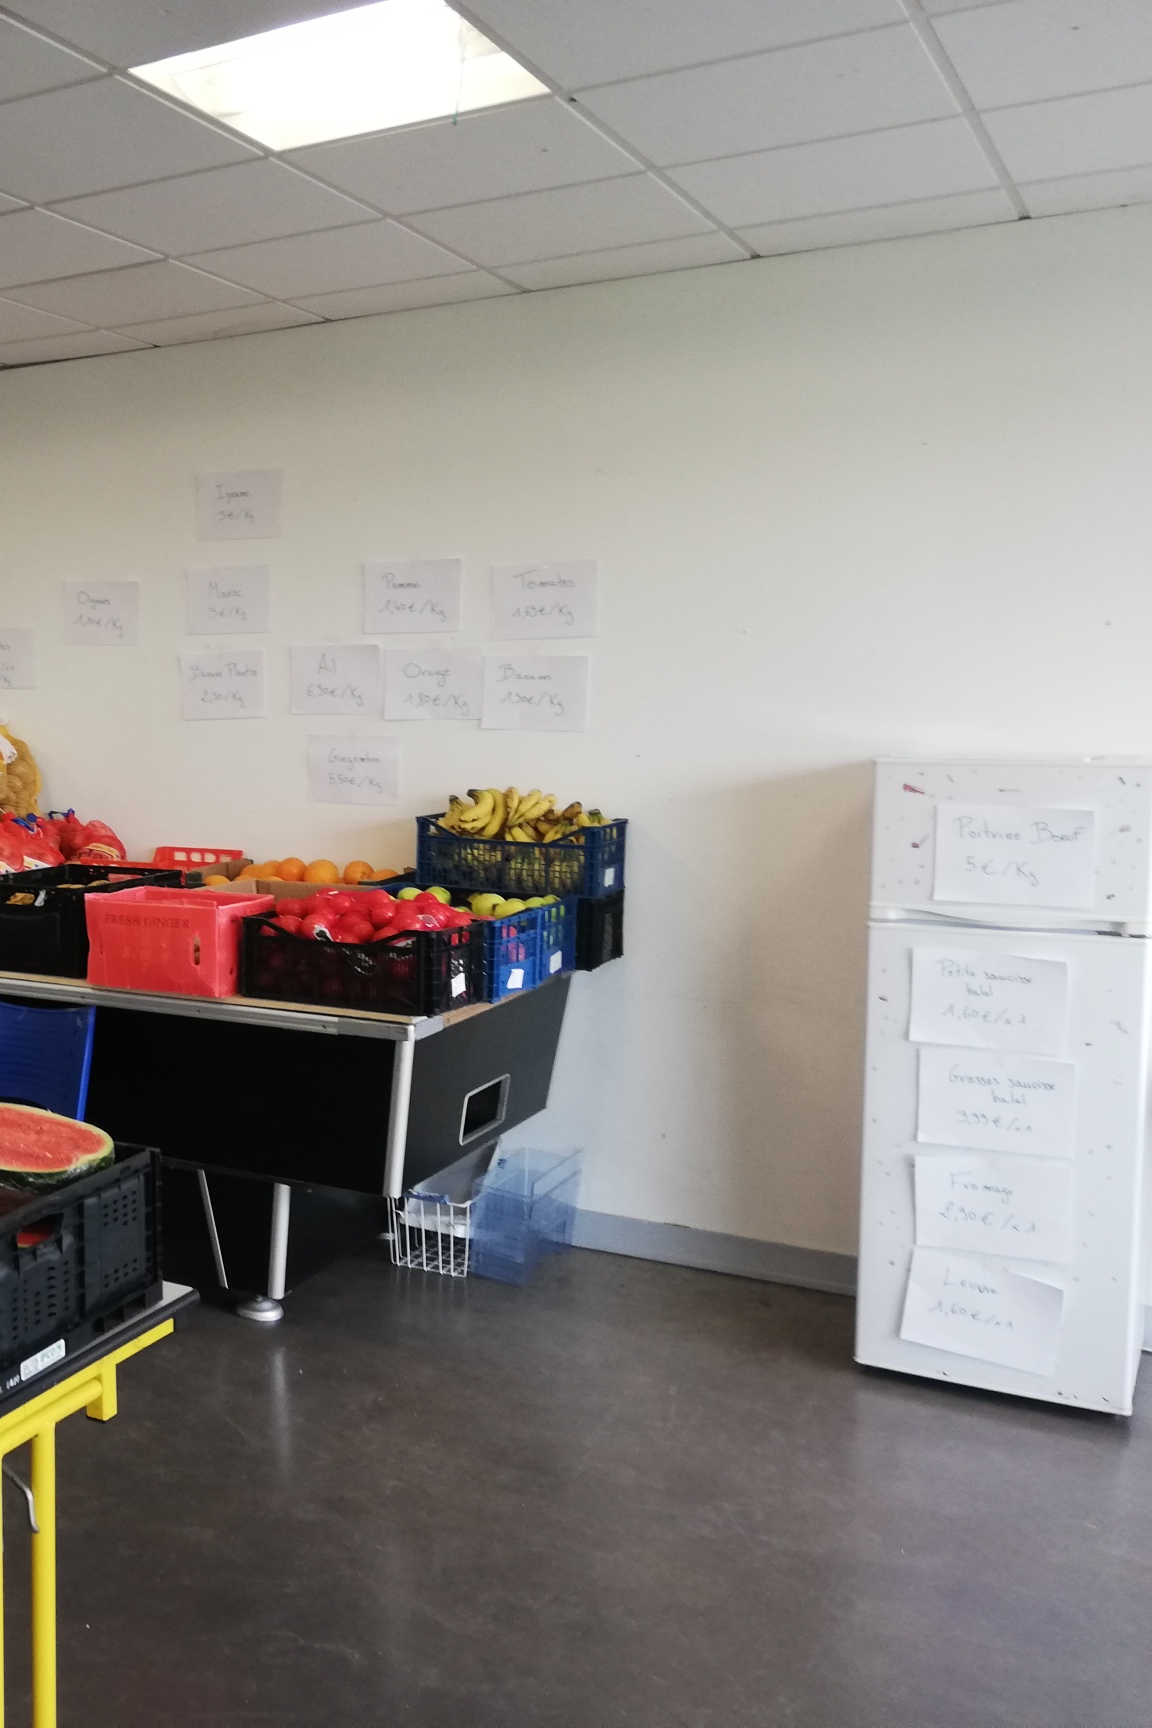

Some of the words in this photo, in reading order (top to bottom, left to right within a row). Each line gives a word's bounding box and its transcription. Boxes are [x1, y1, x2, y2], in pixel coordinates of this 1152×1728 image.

[953, 815, 1021, 842] Poitrine
[105, 914, 140, 926] FRESH
[144, 917, 190, 929] GINGER
[950, 1171, 1013, 1205] Fromage
